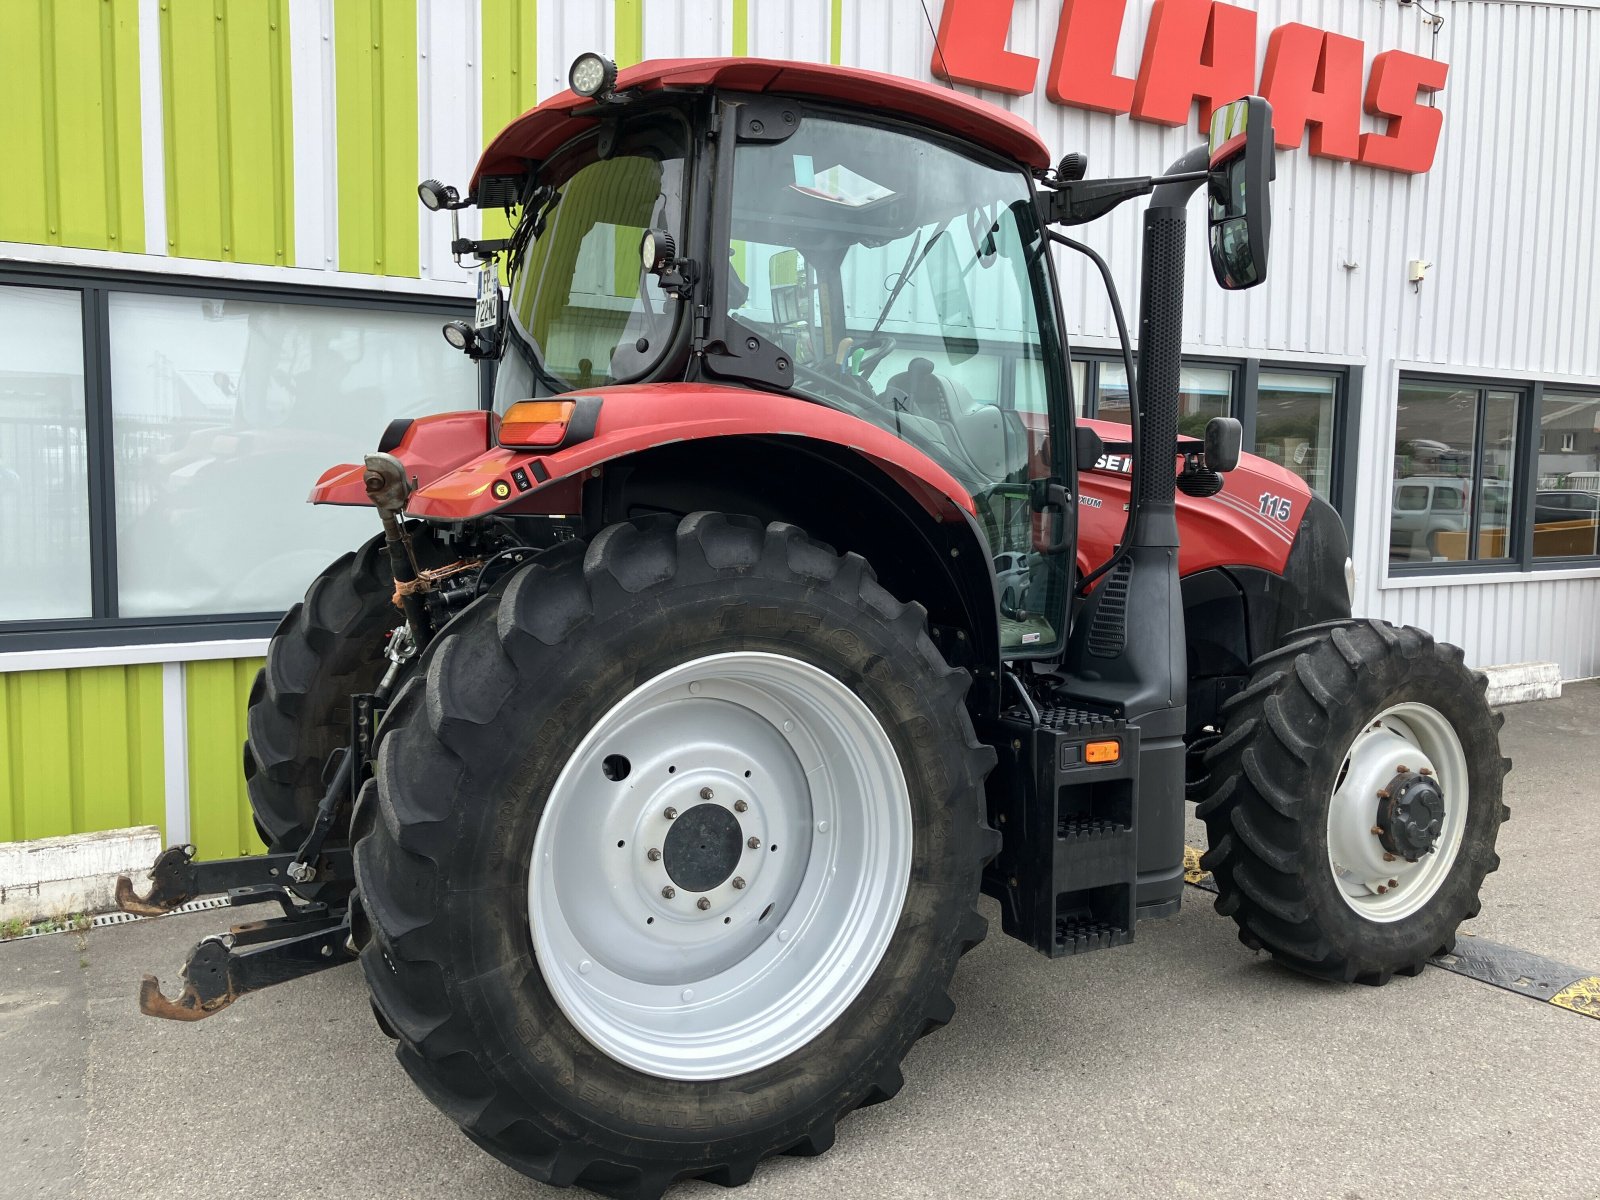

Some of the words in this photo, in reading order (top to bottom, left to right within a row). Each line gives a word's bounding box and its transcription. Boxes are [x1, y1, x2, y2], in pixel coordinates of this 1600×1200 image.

[930, 0, 1449, 175] CLAAS
[1094, 454, 1121, 470] SE
[1079, 495, 1102, 509] XUM
[1259, 492, 1291, 522] 115
